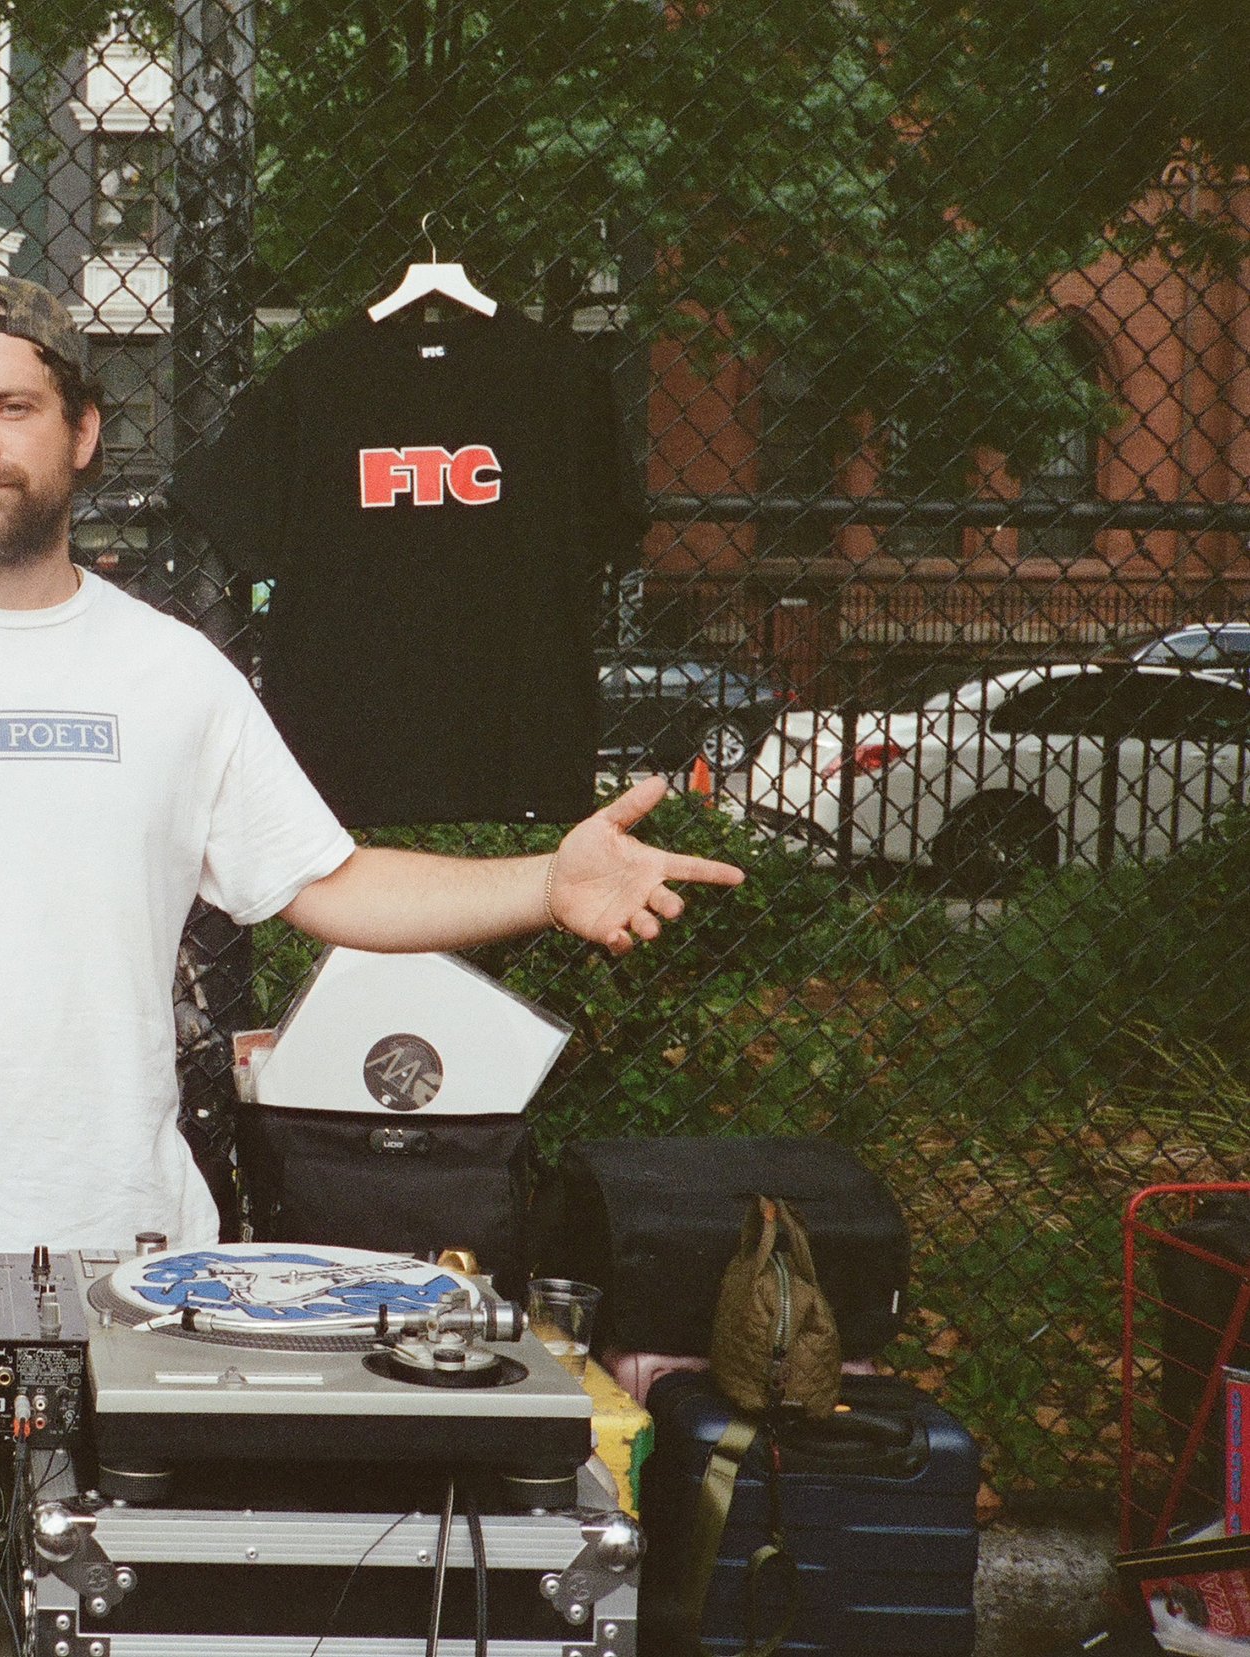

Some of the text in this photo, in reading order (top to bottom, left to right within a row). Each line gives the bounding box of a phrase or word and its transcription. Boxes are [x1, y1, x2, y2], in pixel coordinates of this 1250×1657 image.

[421, 346, 445, 358] FTC
[359, 445, 502, 508] FTC
[8, 722, 109, 749] POETS
